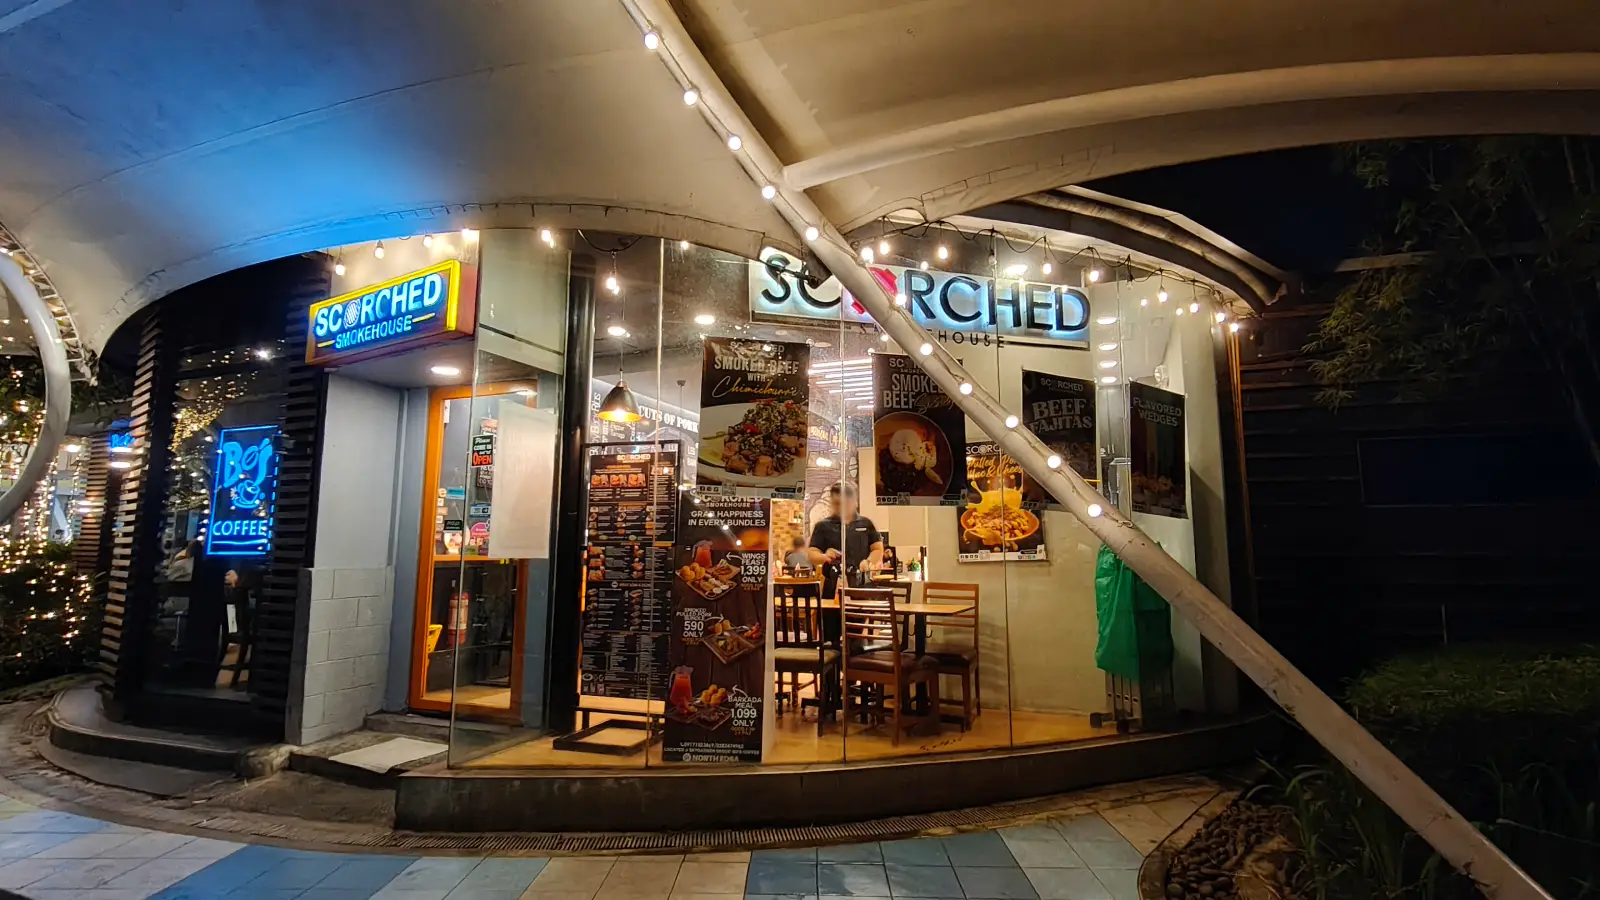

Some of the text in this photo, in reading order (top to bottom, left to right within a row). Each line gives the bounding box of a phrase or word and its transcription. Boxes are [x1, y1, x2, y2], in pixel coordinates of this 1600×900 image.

[315, 273, 442, 337] SCORCHED
[335, 314, 413, 349] SMOKEHOUSE
[860, 322, 1005, 348] SHOUSE
[769, 359, 800, 375] BEEF
[747, 372, 766, 382] WITH
[1040, 377, 1084, 392] SCRCHED
[883, 390, 916, 409] BEEF
[1133, 397, 1182, 417] FLAVORED
[1032, 398, 1088, 420] BEEF
[638, 405, 699, 433] CUTS OF PORK
[1029, 415, 1093, 433] FAJITAS
[1138, 408, 1179, 427] WEDGES
[966, 444, 1001, 455] SCORC
[222, 438, 273, 488] Bo's
[473, 452, 492, 466] OPEN
[716, 510, 764, 518] HAPPINESS
[213, 520, 269, 537] COFFEE
[698, 519, 726, 527] EVERY
[727, 519, 766, 527] BUNDLES
[741, 552, 766, 560] WINGS
[740, 565, 767, 576] 1,399
[683, 620, 705, 631] 590
[730, 708, 758, 719] 1,099
[732, 719, 755, 727] ONLY
